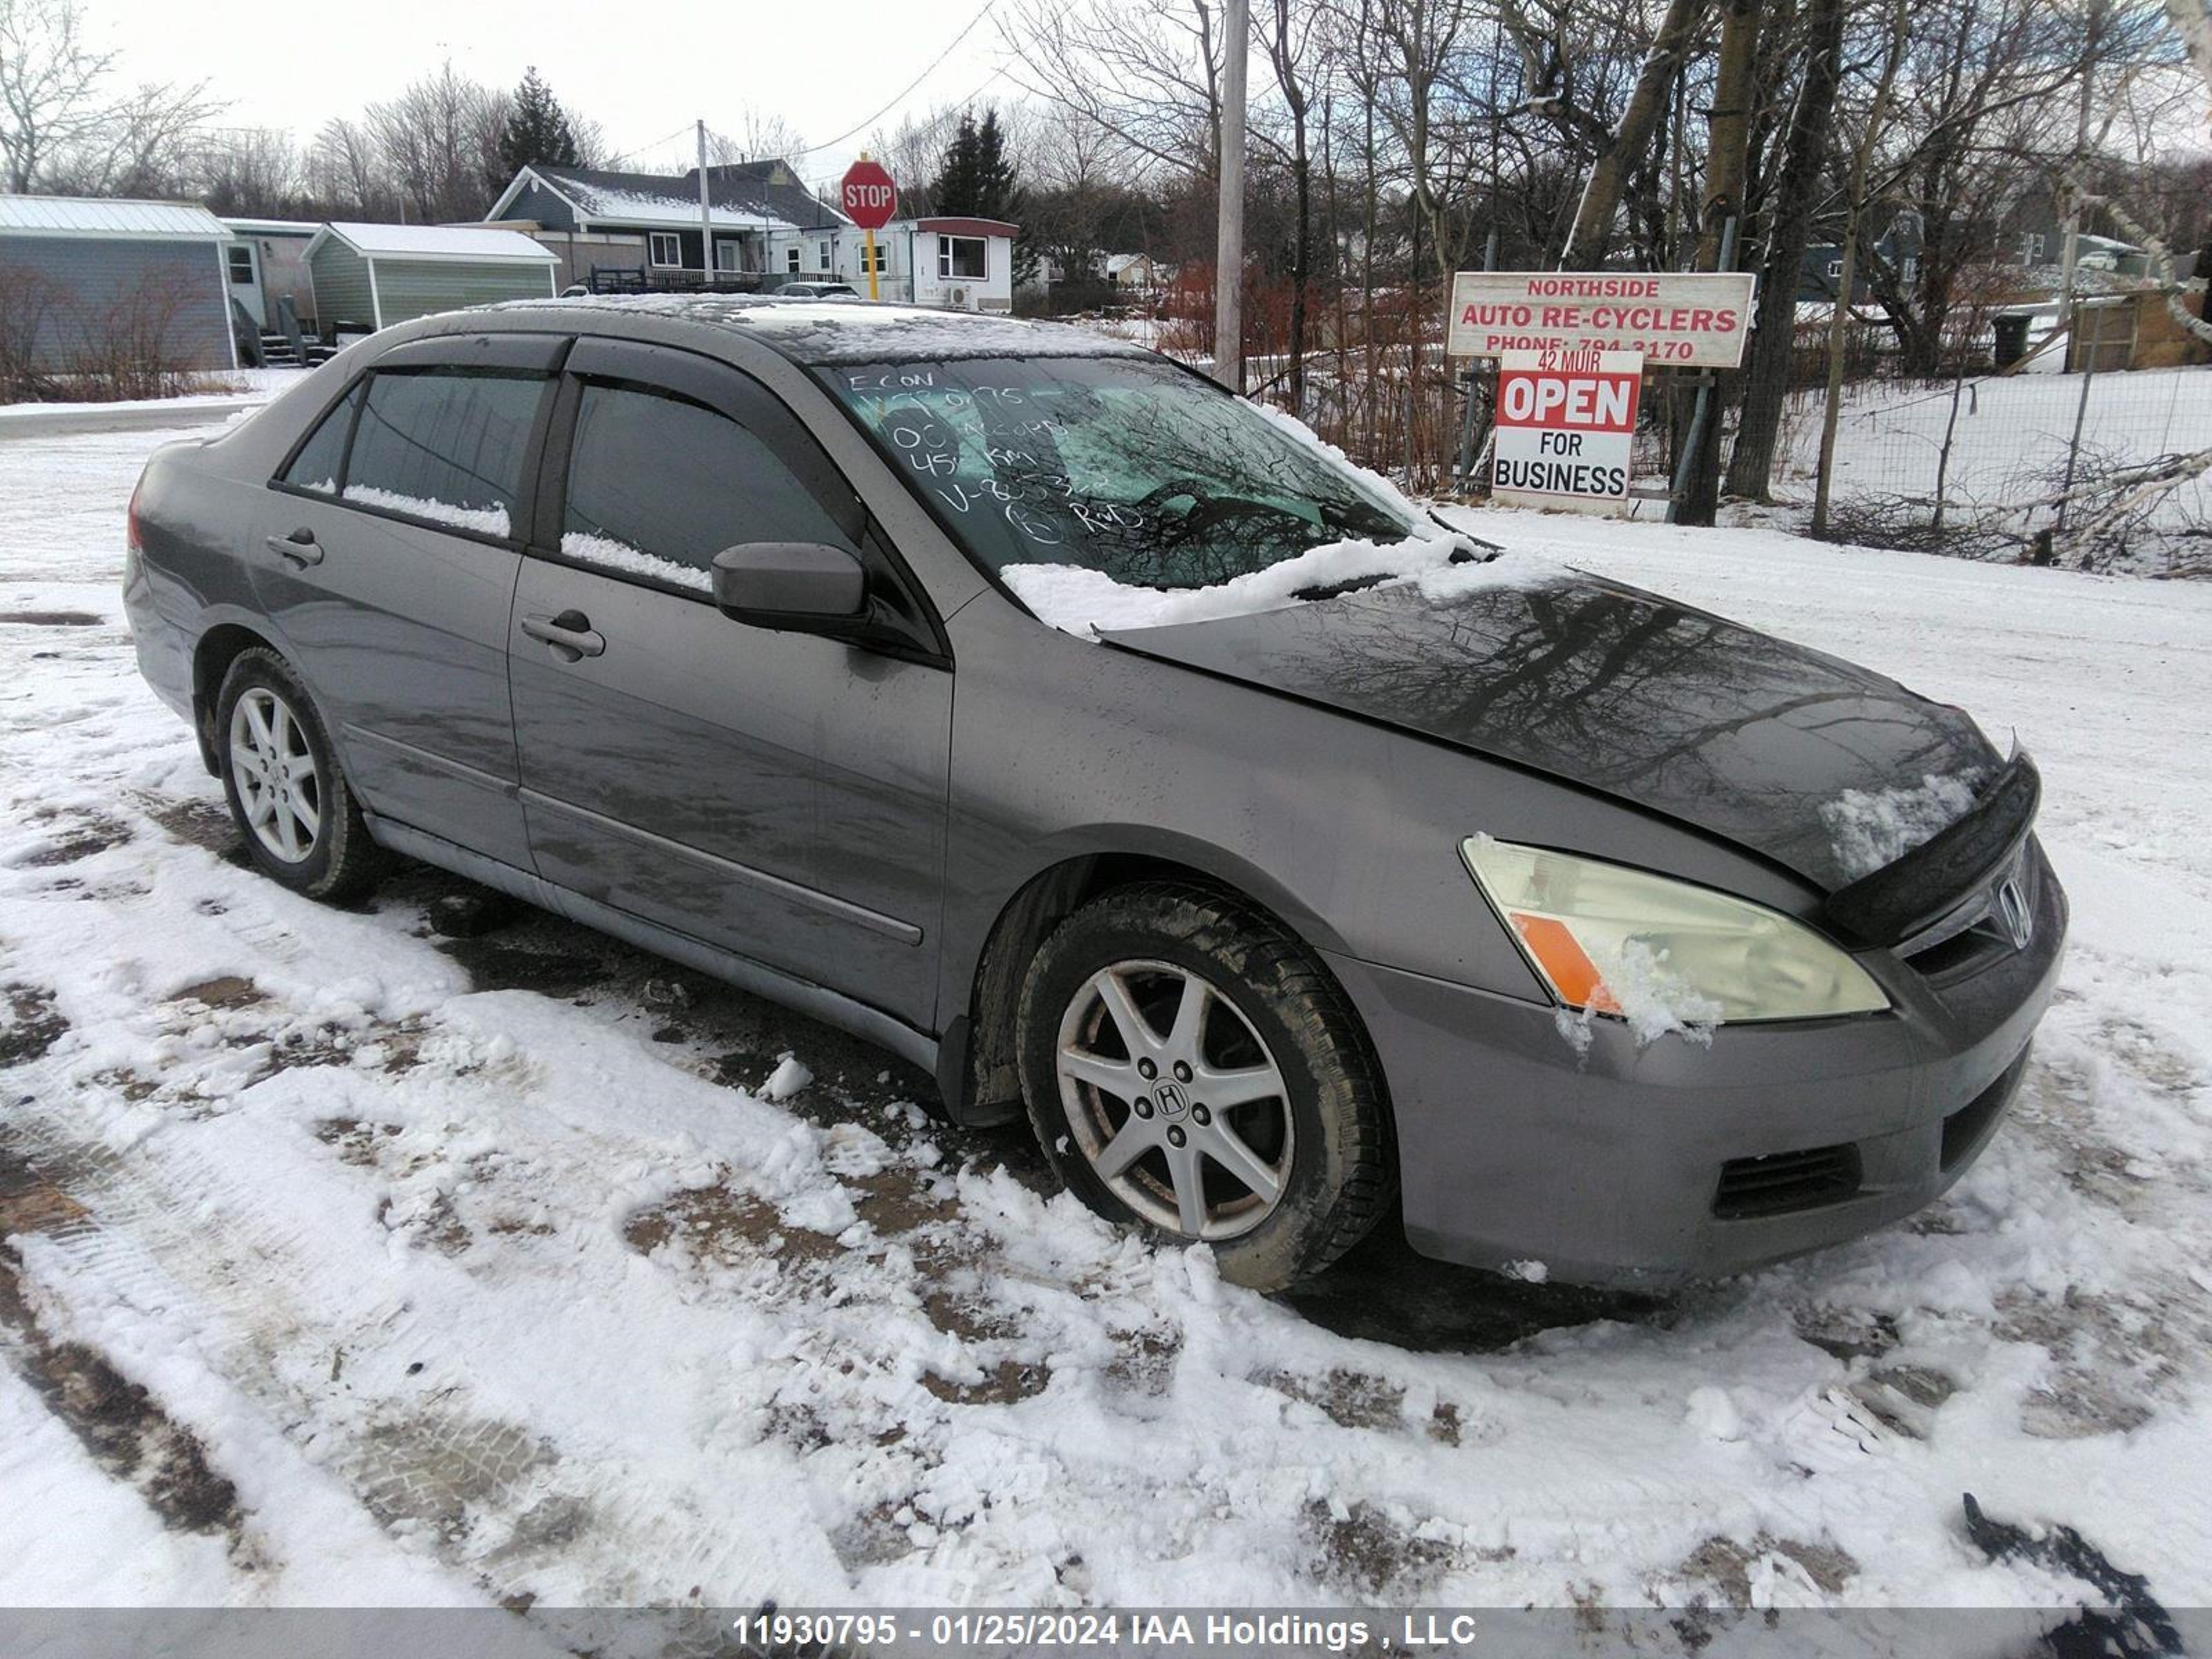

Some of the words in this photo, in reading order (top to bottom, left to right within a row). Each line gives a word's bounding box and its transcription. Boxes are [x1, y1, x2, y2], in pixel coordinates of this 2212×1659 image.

[846, 185, 892, 207] STOP
[1528, 280, 1659, 297] NORTHSIDE
[1462, 305, 1531, 326] AUTO
[1542, 306, 1737, 332] RE-CYCLERS
[1538, 350, 1557, 371] 42
[1562, 350, 1601, 373] MUIR
[1504, 377, 1631, 425] OPEN
[1541, 431, 1583, 456] FOR
[1495, 459, 1625, 496] BUSINESS
